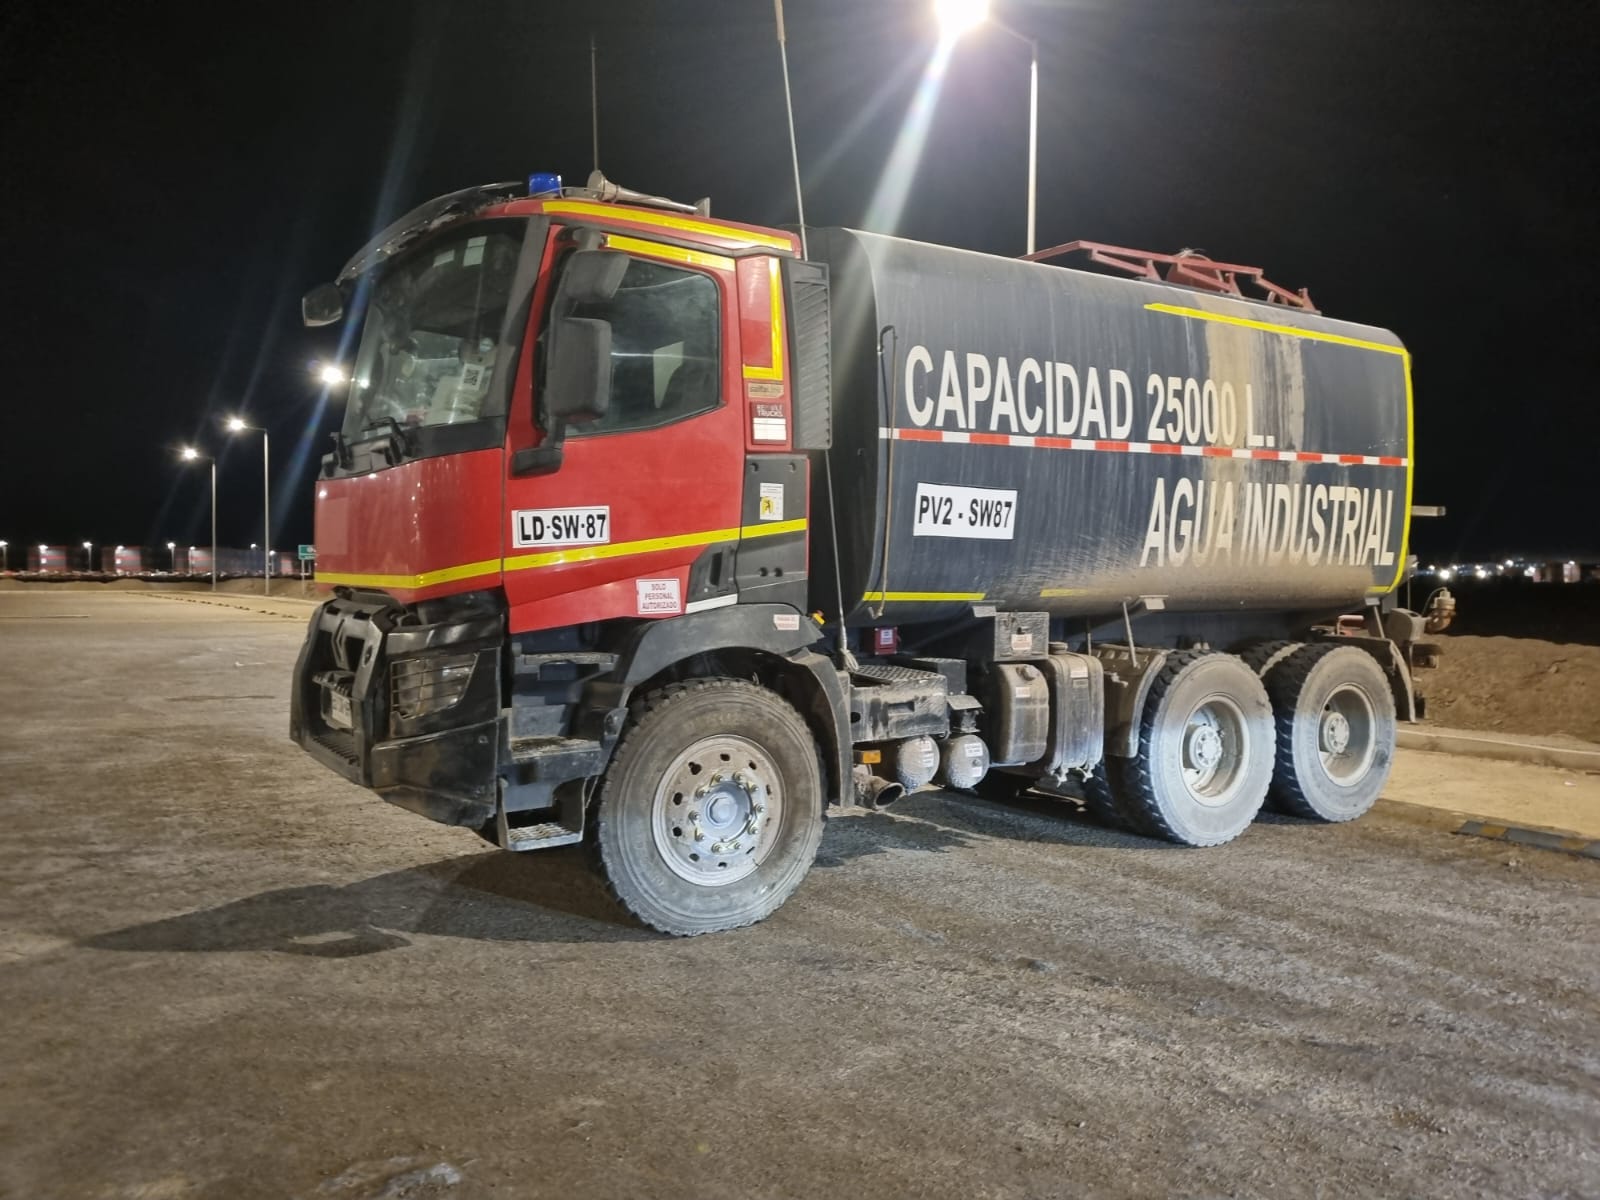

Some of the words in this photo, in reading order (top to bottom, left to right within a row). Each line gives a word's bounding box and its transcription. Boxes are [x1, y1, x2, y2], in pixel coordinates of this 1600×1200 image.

[904, 345, 1133, 440] CAPACIDAD
[1146, 373, 1237, 446] 25000
[1245, 383, 1275, 448] L.
[918, 494, 953, 525] PV2
[968, 498, 1013, 528] SW87
[1139, 477, 1234, 568] AGUA
[1239, 482, 1395, 567] INDUSTRIAL
